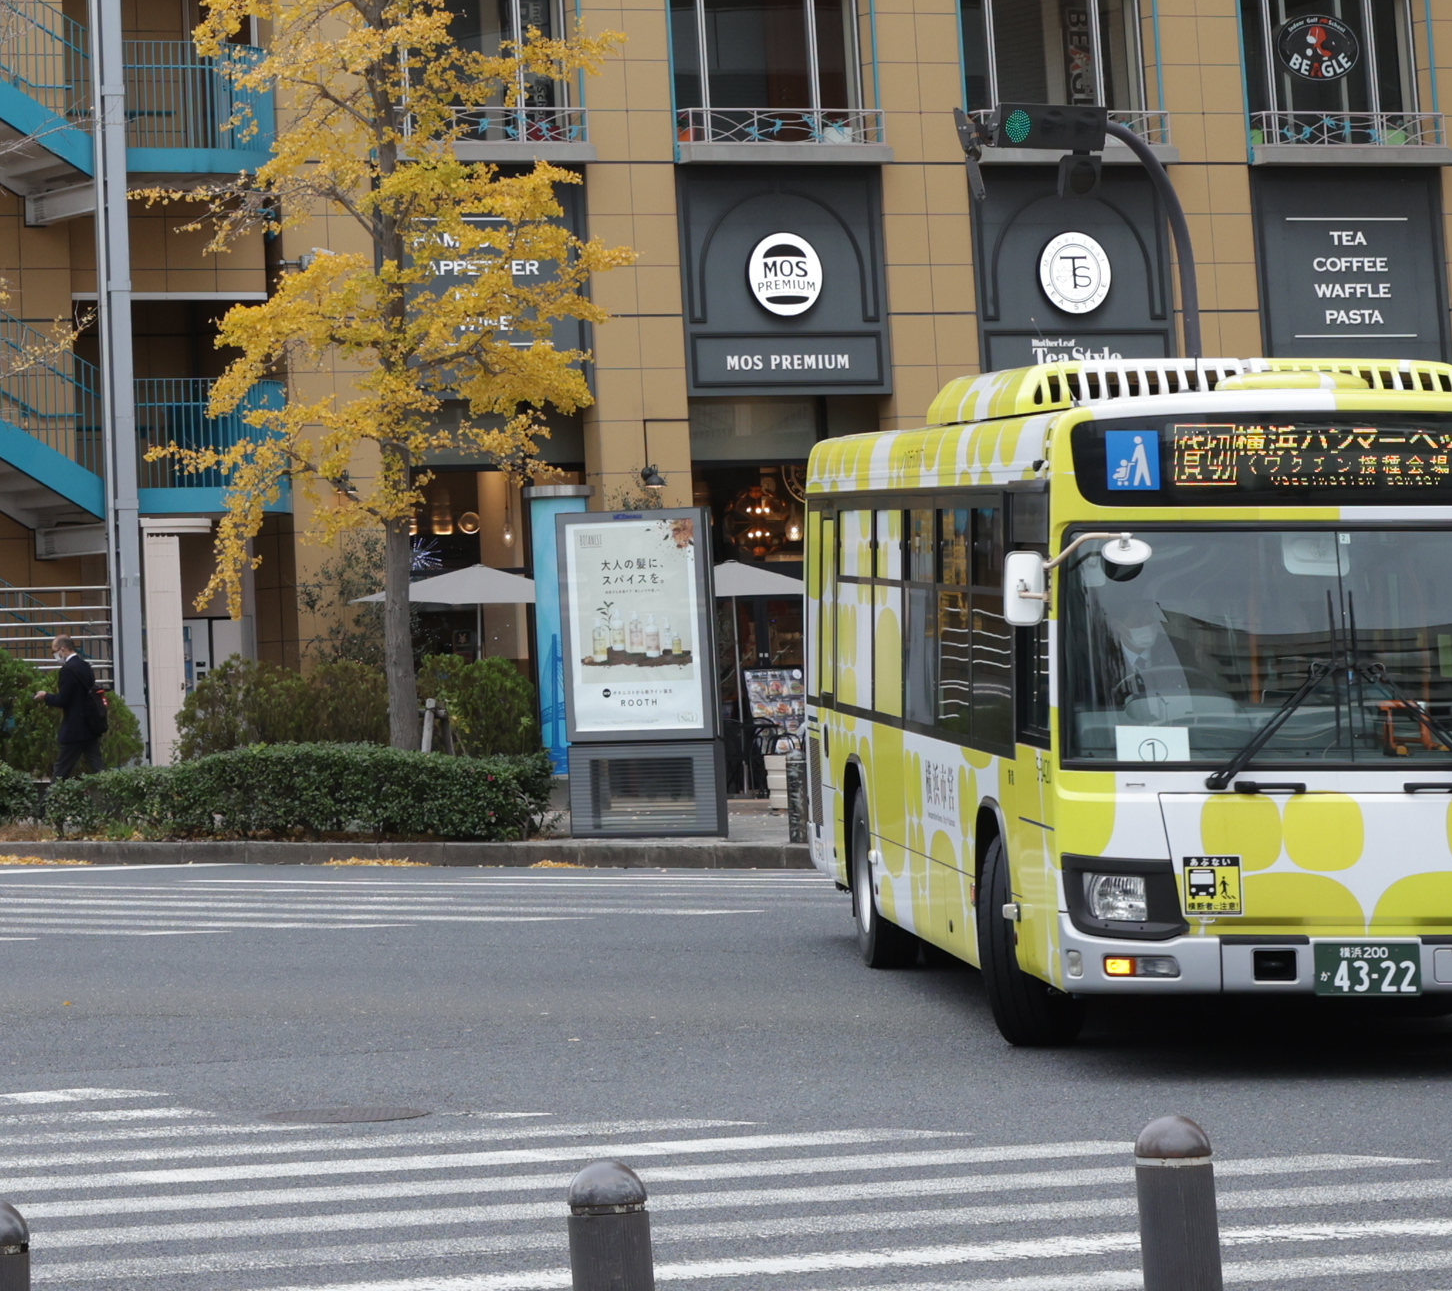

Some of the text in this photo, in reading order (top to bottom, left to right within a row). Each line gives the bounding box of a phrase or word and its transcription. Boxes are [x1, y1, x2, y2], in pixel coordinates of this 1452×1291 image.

[1289, 53, 1352, 77] BEAGLE
[1329, 231, 1367, 245] TEA
[763, 260, 808, 278] MOS
[1313, 257, 1388, 272] COFFEE
[1060, 256, 1092, 289] TS
[757, 279, 816, 293] PREMIUM
[1314, 283, 1391, 298] WAFFLE
[1325, 309, 1384, 324] PASTA
[726, 354, 849, 370] MOS PREMIUM
[601, 558, 664, 571] 大人の髪に、
[602, 573, 665, 586] スパイスを。
[620, 699, 658, 707] ROOTH
[1190, 858, 1231, 866] あぶない
[1334, 961, 1417, 993] 43-22
